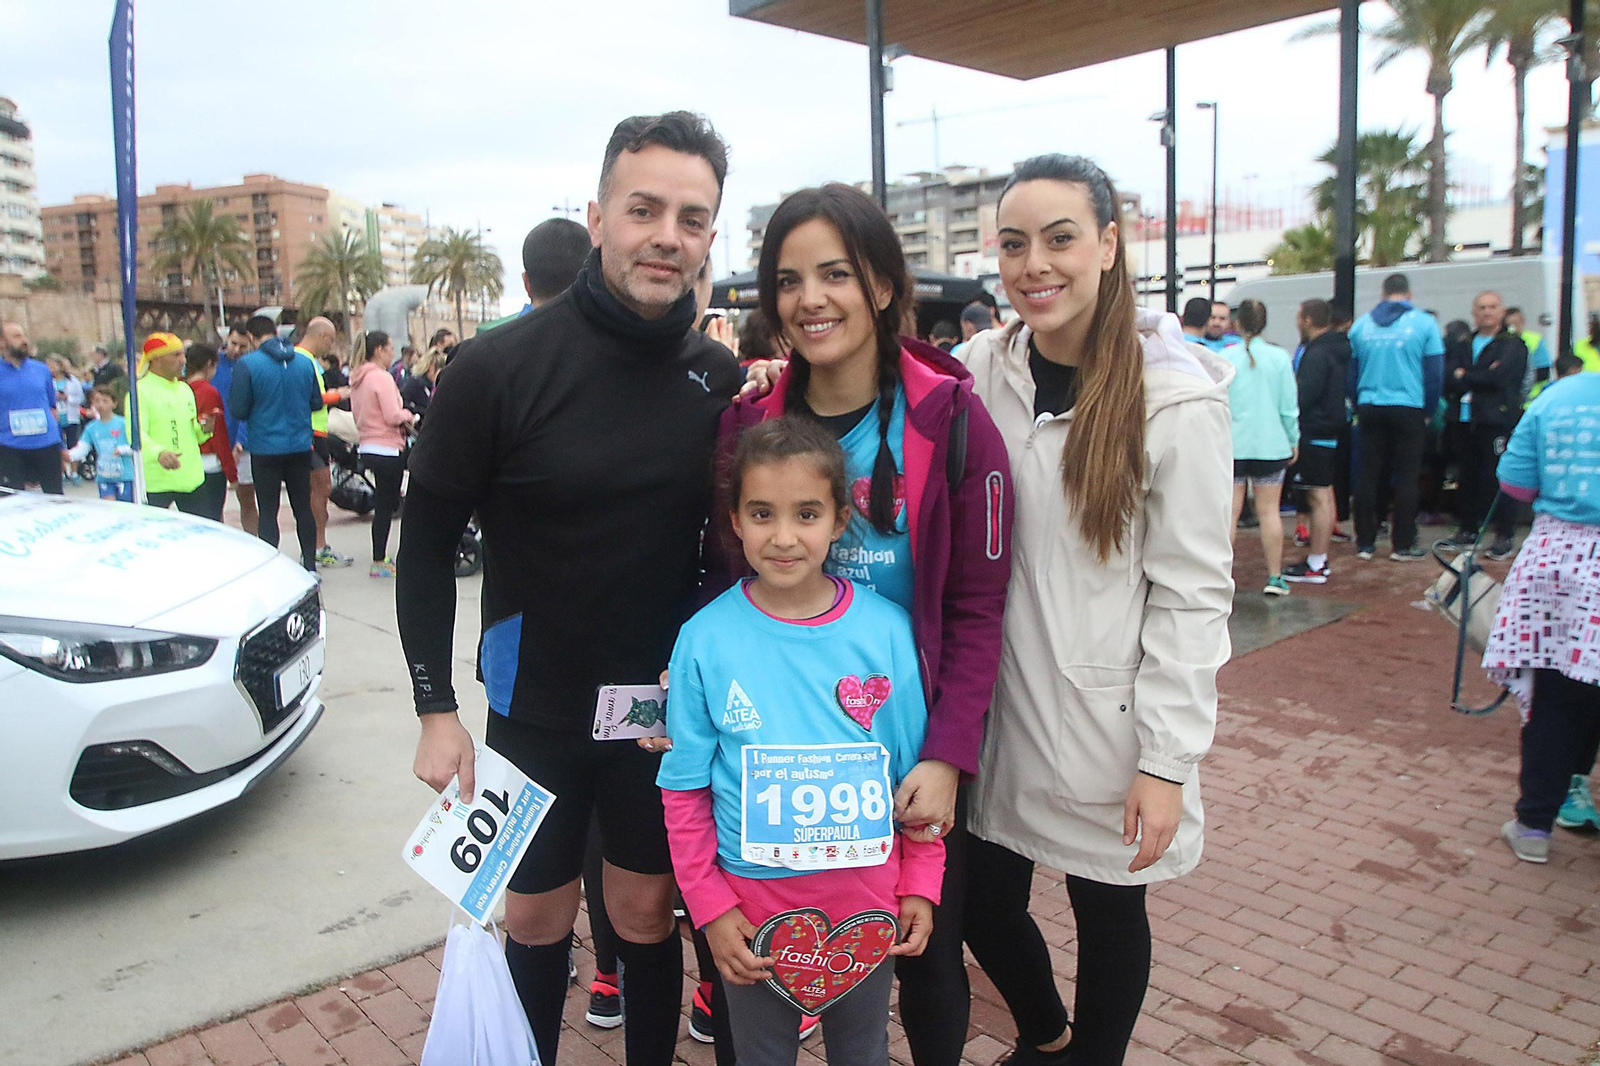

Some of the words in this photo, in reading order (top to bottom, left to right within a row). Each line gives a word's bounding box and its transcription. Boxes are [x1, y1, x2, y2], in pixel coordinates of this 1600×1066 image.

[837, 565, 870, 580] azul
[722, 707, 762, 726] ALTEA
[761, 753, 795, 765] Runner
[797, 753, 832, 766] Fashion
[754, 769, 772, 780] por
[775, 767, 788, 780] el
[791, 767, 834, 782] autismo
[520, 788, 532, 806] por
[756, 779, 887, 826] 1998
[522, 802, 541, 830] Runner
[450, 788, 510, 874] 109
[496, 816, 518, 852] autismo
[486, 860, 508, 893] Carrera
[475, 893, 489, 911] azul
[800, 985, 827, 995] ALTEA
